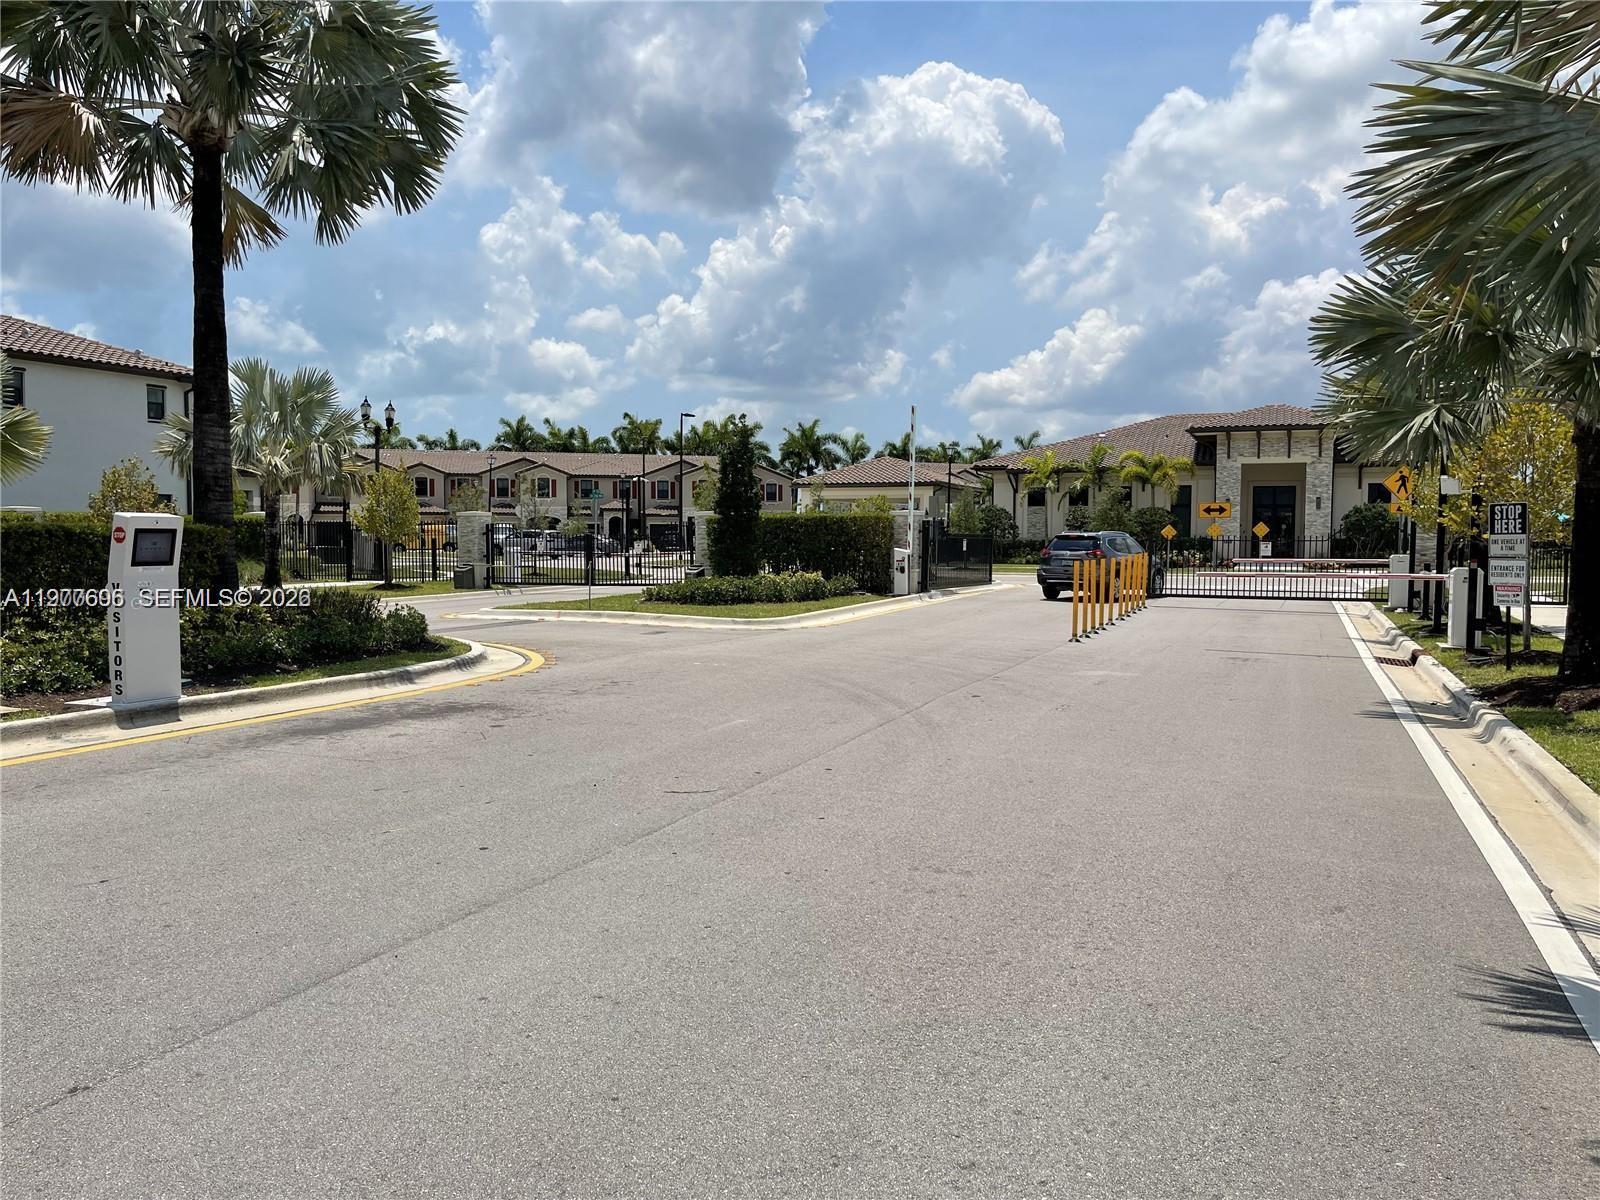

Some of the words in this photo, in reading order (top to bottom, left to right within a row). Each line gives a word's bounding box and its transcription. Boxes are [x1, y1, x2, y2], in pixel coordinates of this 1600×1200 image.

[1494, 505, 1522, 519] STOP
[1494, 519, 1522, 533] HERE
[113, 531, 125, 539] STOP
